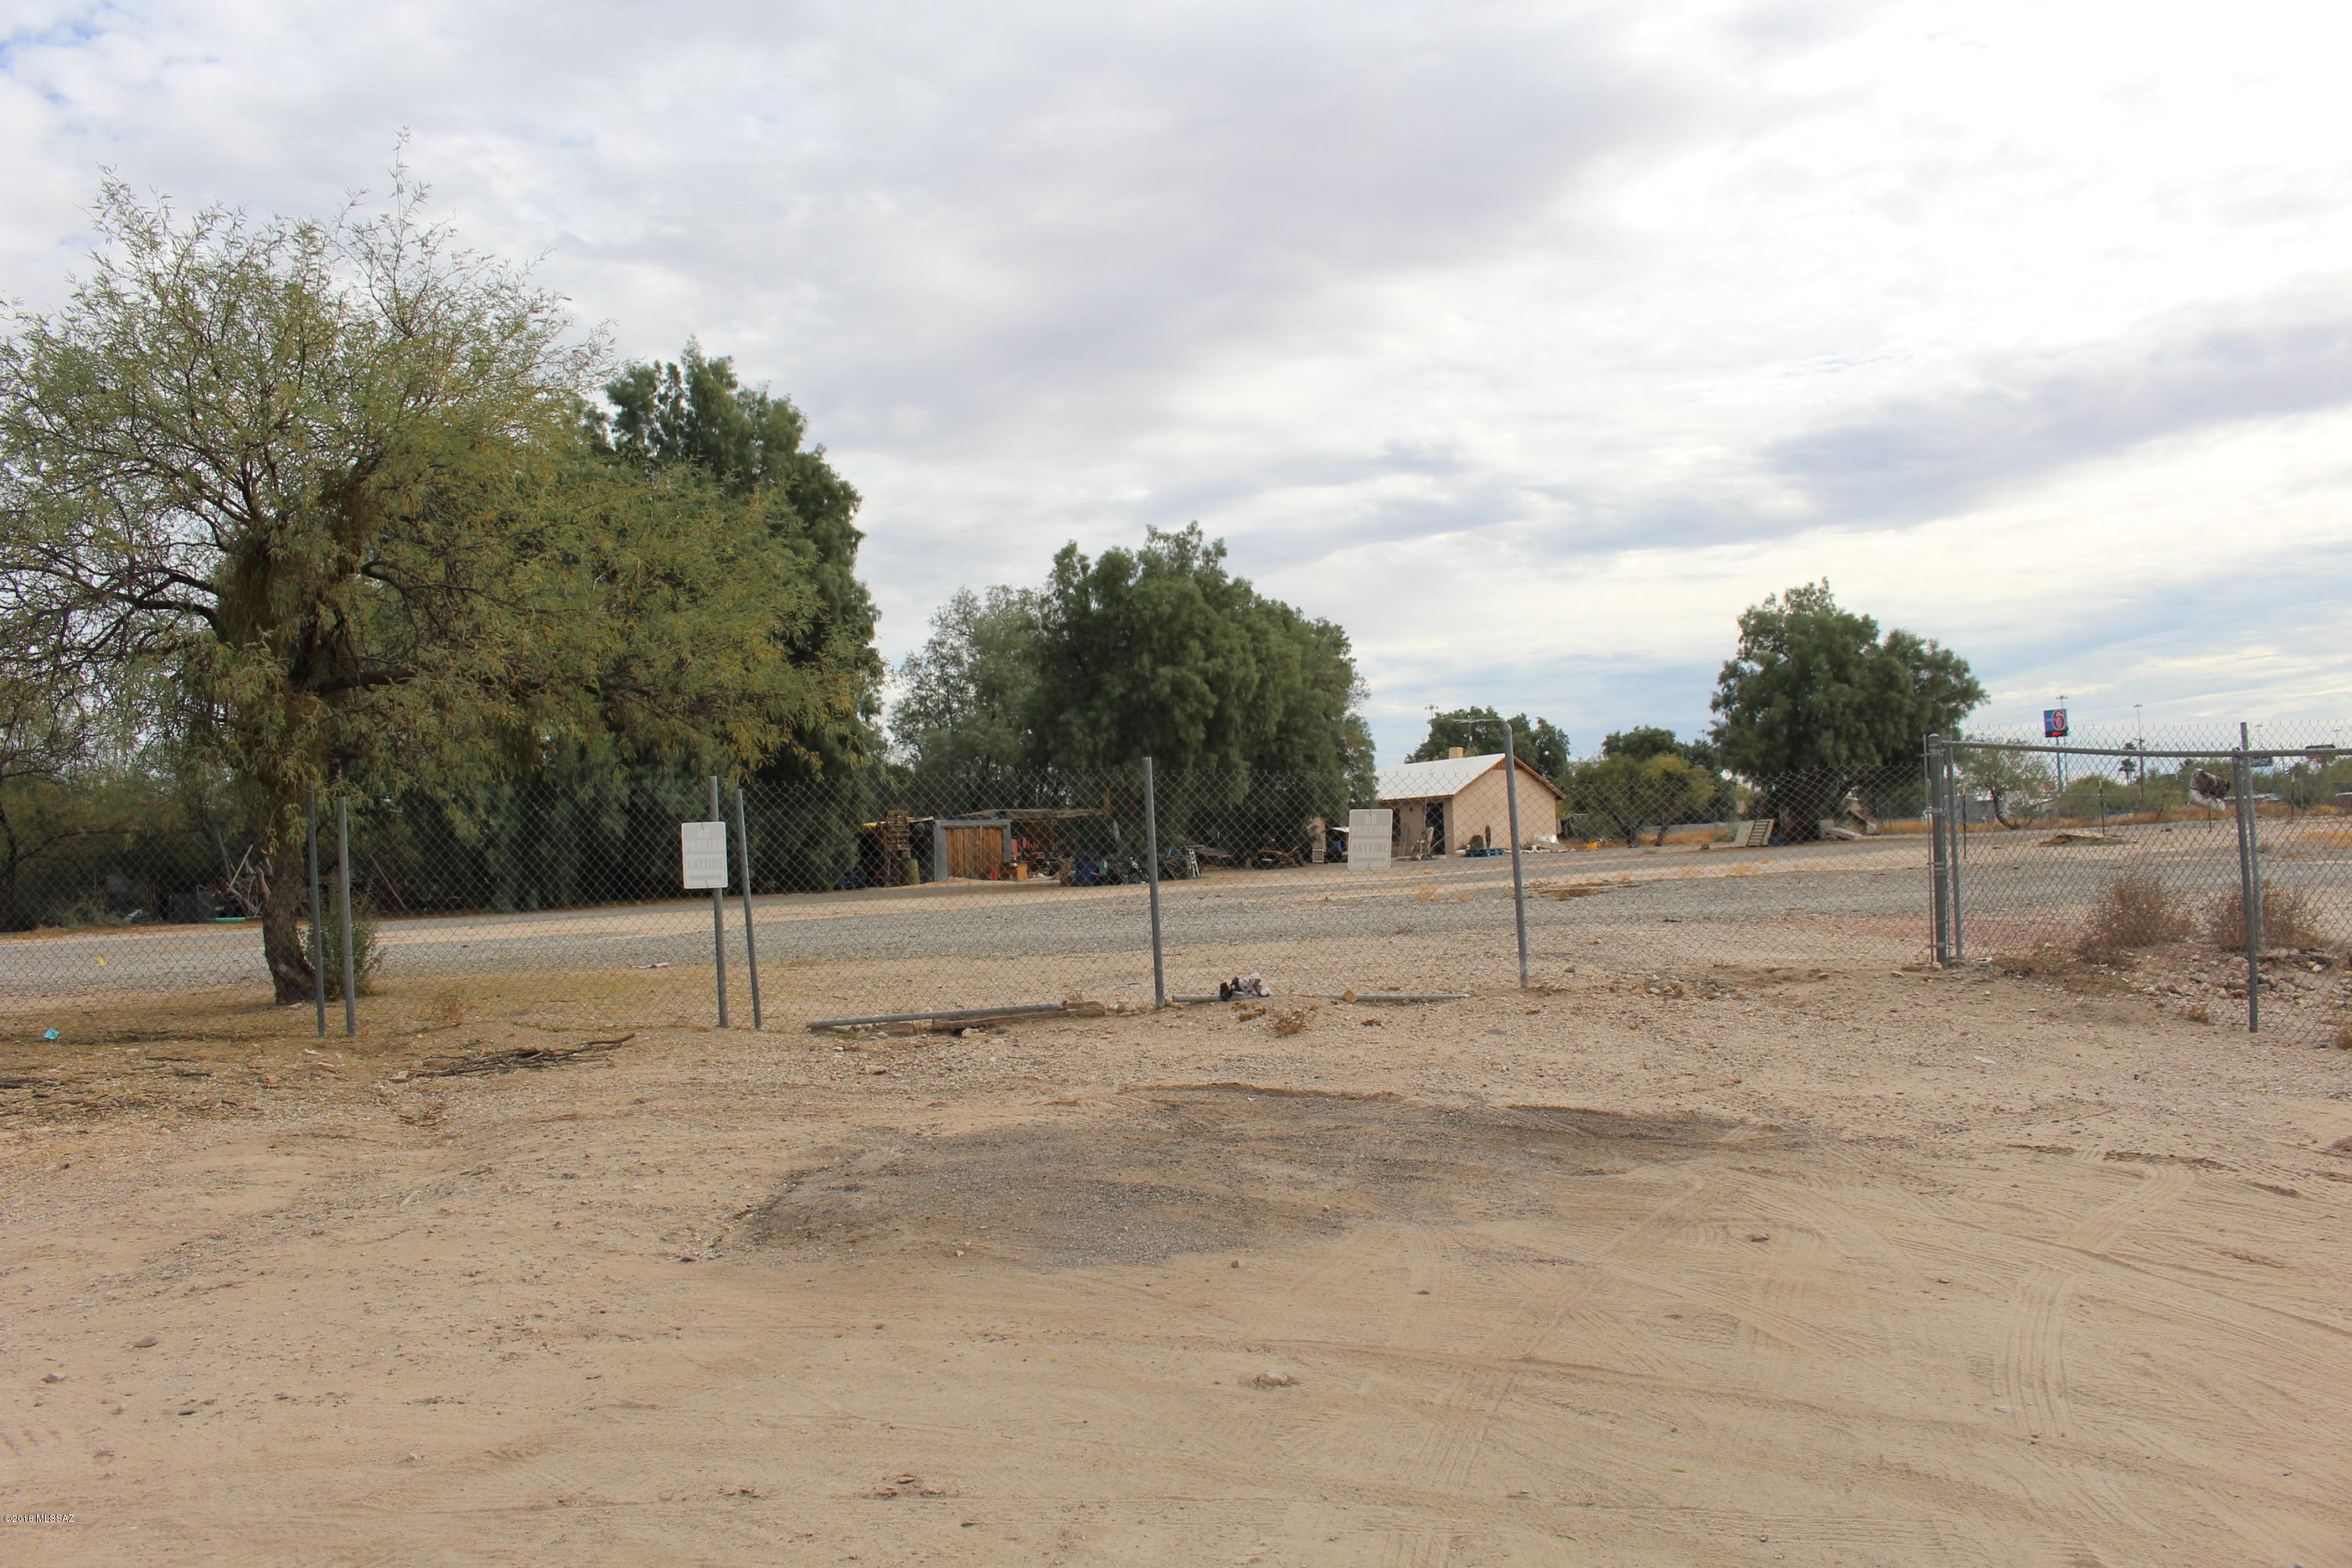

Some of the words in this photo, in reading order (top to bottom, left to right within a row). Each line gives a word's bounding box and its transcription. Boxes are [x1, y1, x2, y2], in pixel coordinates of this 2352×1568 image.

[2052, 710, 2066, 730] 6
[1352, 825, 1389, 836] PARKING
[1351, 842, 1388, 853] ANYTIME
